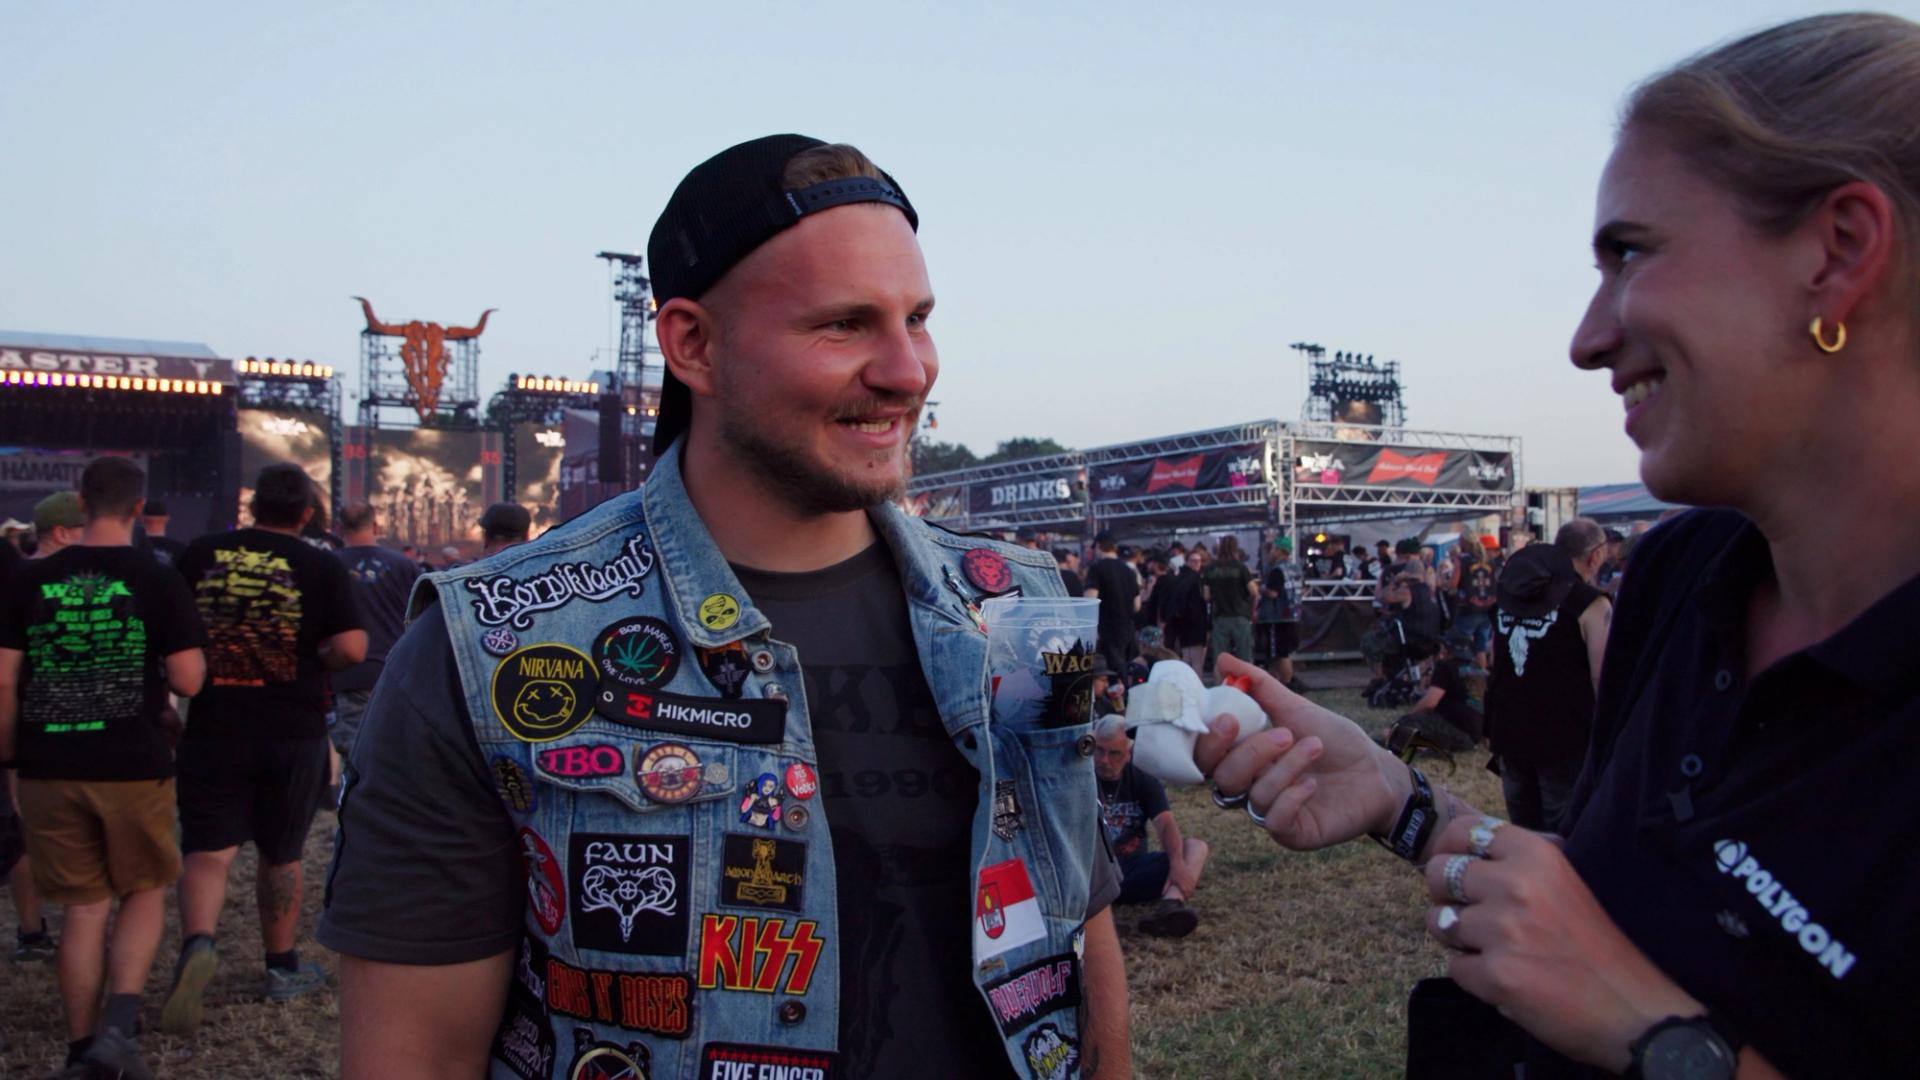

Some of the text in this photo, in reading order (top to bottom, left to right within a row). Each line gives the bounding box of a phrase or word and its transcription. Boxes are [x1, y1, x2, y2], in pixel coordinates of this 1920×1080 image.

[991, 478, 1071, 505] DRINKS
[618, 623, 675, 656] BOB MARLEY
[519, 656, 585, 680] NIRVANA
[601, 658, 616, 676] ONE
[1042, 652, 1094, 676] WAC
[656, 702, 752, 729] HIKMICRO
[1731, 854, 1857, 980] POLYGON
[698, 914, 824, 994] KISS
[547, 959, 591, 1019] GUNS
[619, 974, 689, 1034] ROSES
